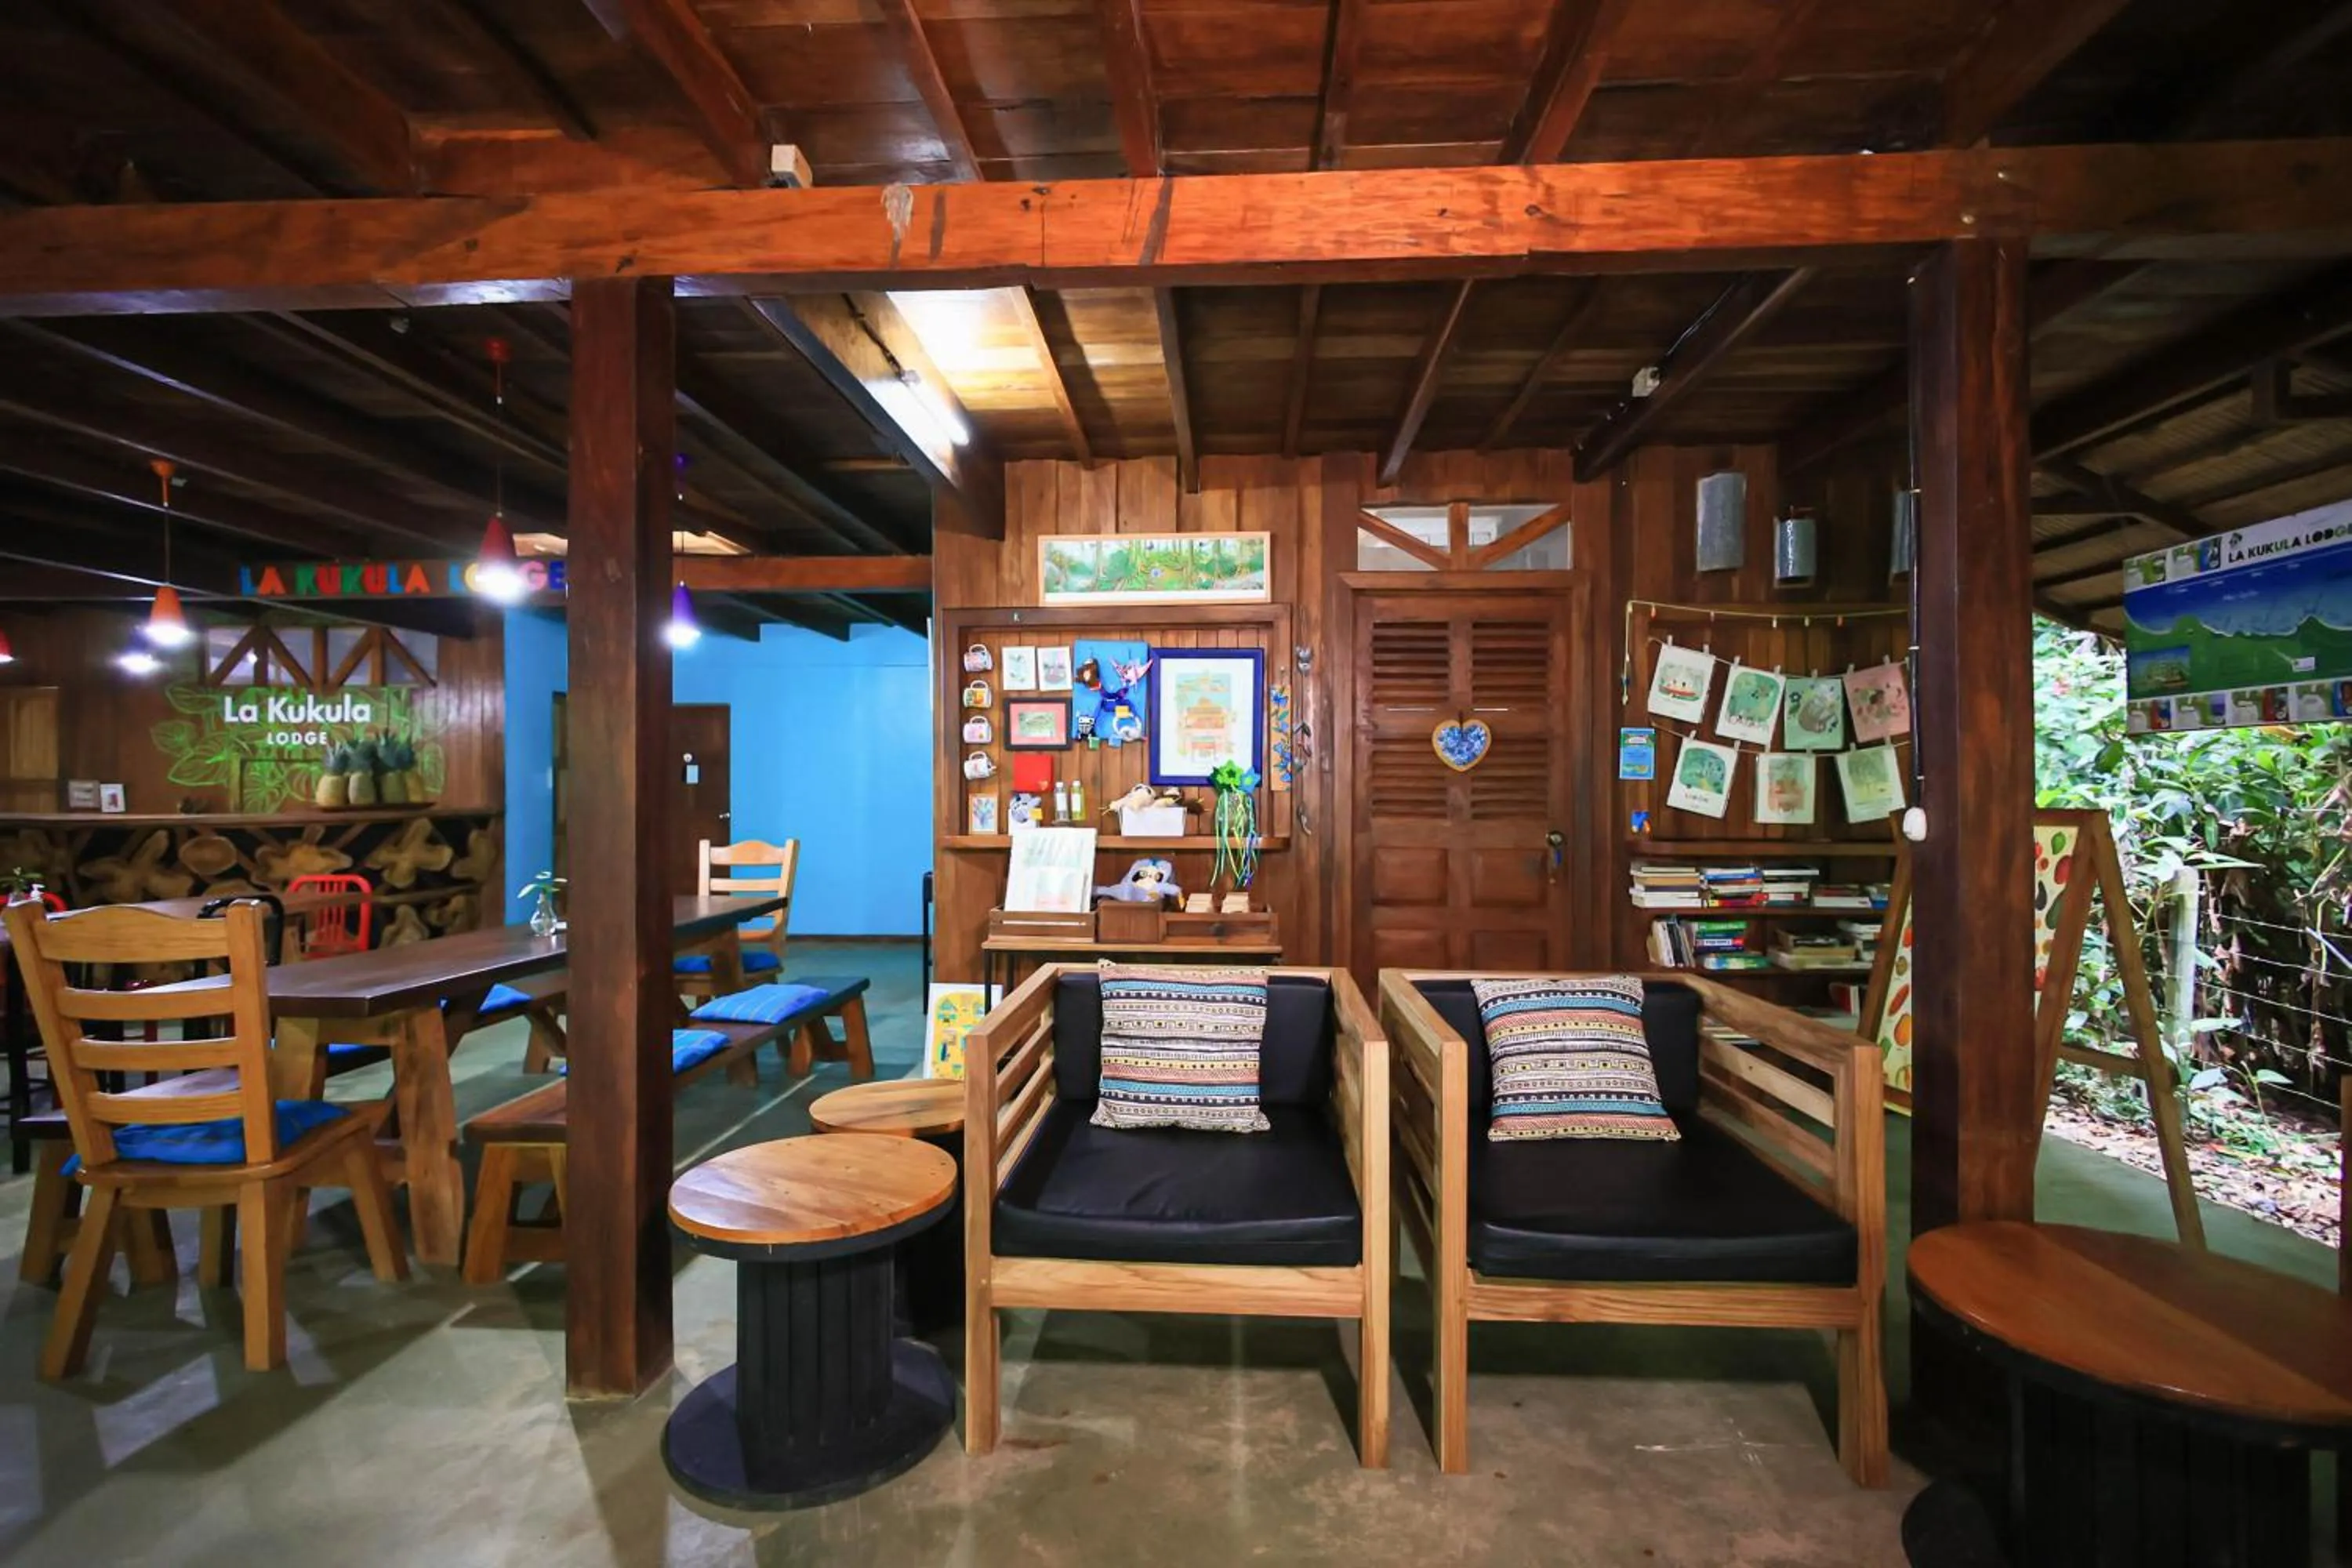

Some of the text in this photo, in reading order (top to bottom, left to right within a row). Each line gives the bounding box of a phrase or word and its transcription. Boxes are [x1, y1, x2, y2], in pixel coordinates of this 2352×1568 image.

[2228, 550, 2245, 563] LA
[2248, 536, 2301, 558] KUKULA
[239, 564, 285, 595] LA
[295, 563, 430, 595] KUKULA
[224, 694, 371, 723] La Kukula
[267, 731, 328, 745] LODGE
